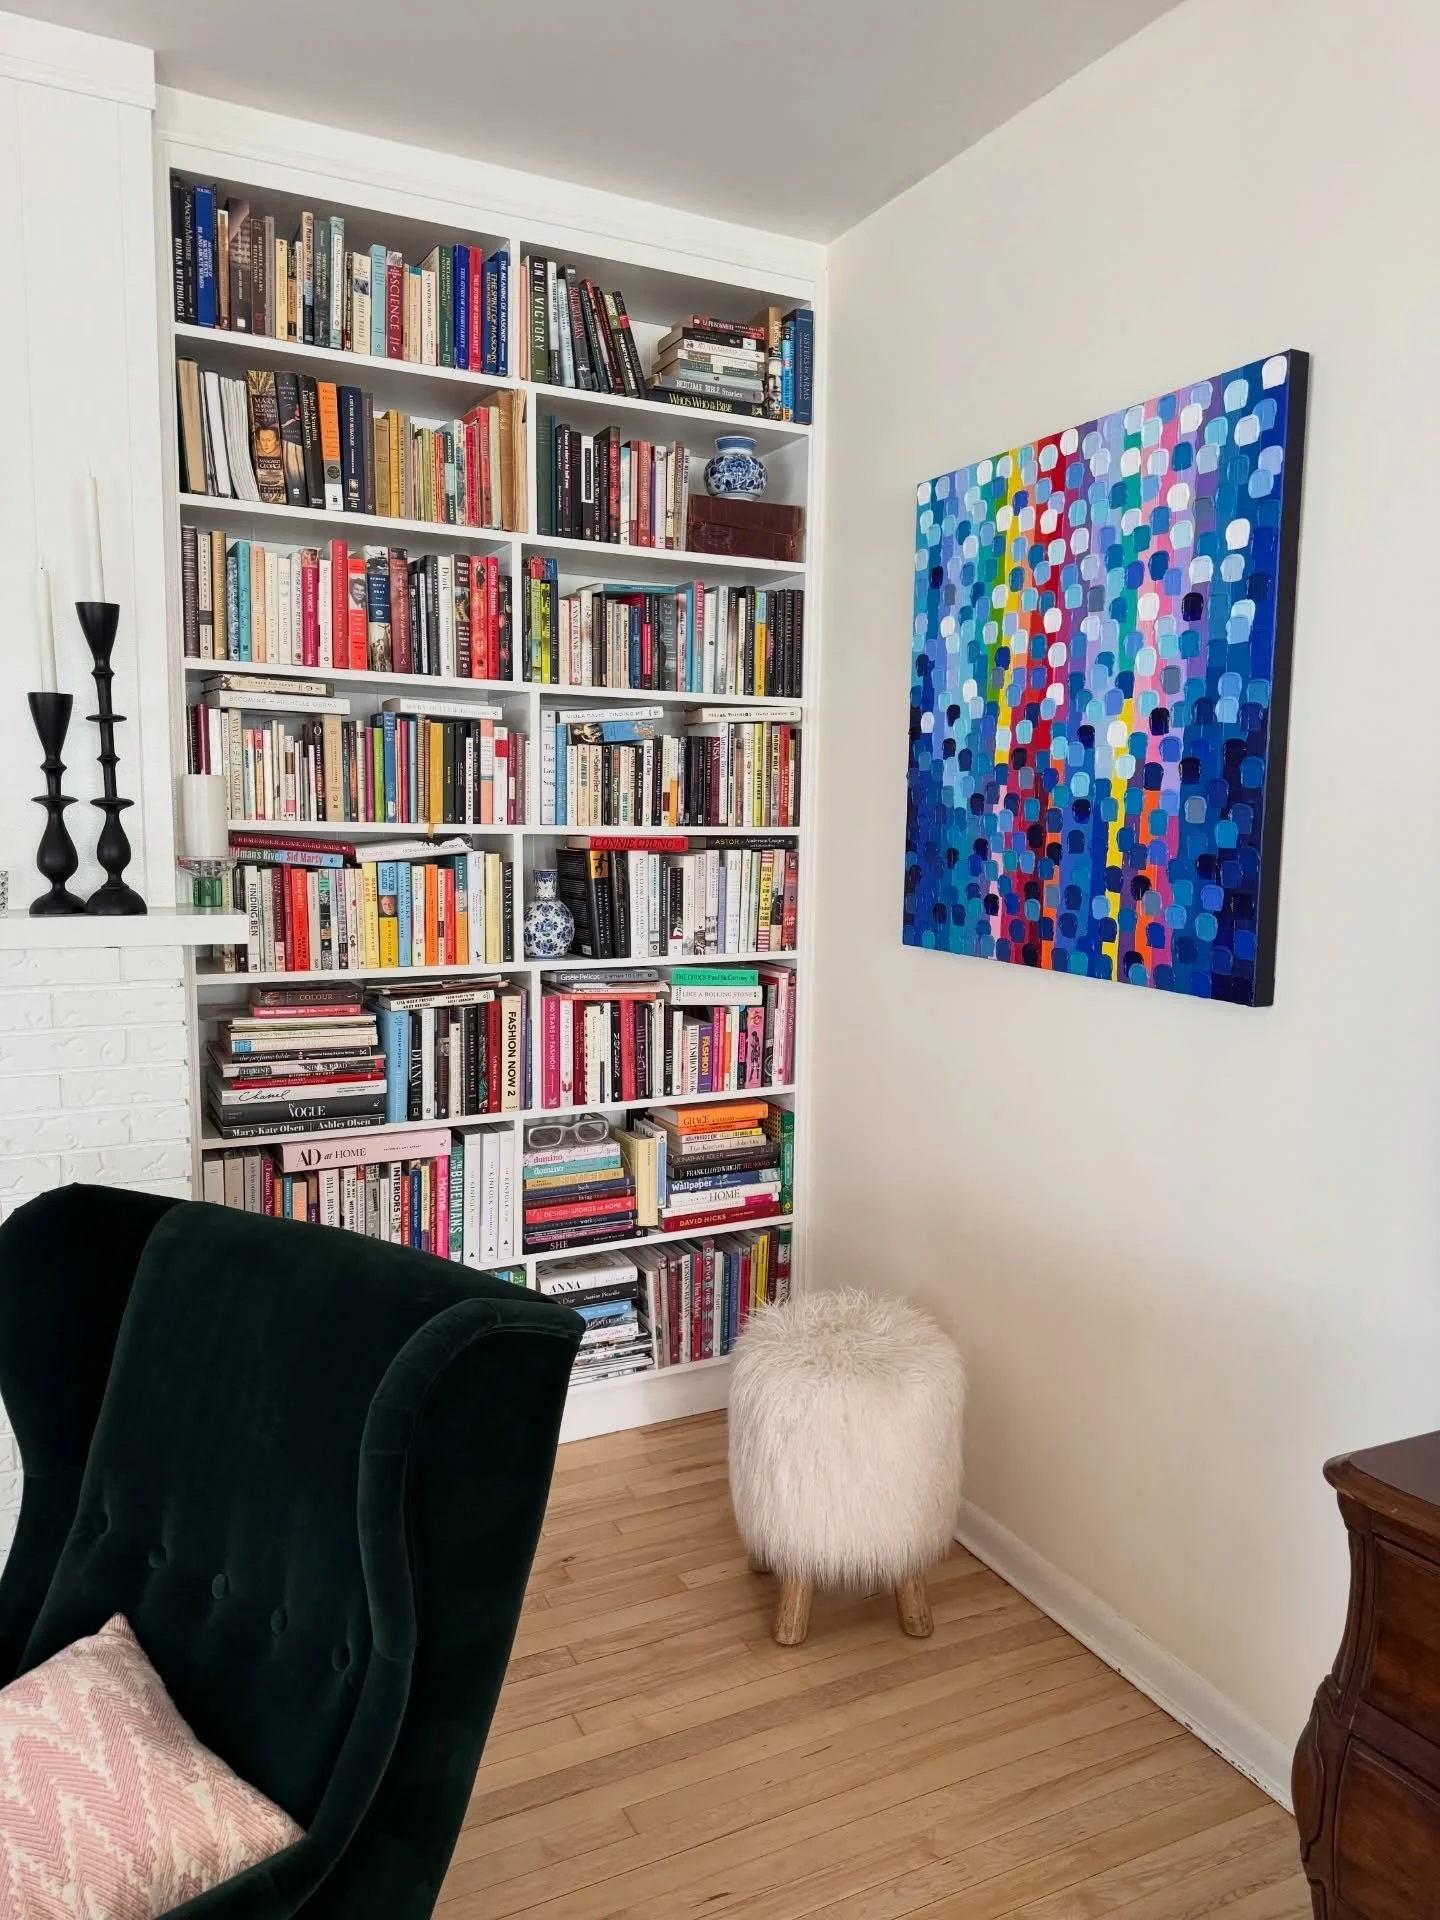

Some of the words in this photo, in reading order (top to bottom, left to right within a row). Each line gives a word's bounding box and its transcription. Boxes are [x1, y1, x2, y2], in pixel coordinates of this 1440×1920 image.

[174, 237, 183, 265] ROMAN
[176, 268, 185, 316] MYTHOLOGY
[390, 279, 400, 330] SCIENCE
[534, 297, 545, 351] VICTORY
[593, 838, 635, 849] CONNIE
[637, 838, 674, 849] CHUNG
[287, 852, 297, 861] Sid
[300, 853, 323, 863] Marty
[250, 883, 258, 918] FINDING
[299, 993, 333, 1001] COLOUR
[508, 1011, 516, 1058] FASHION
[702, 1036, 710, 1076] FASHION
[411, 1049, 421, 1086] DIANA
[508, 1060, 516, 1088] NOW
[238, 1089, 291, 1102] Chanel
[289, 1105, 326, 1118] VOGUE
[232, 1126, 278, 1137] Mary-Kate
[280, 1124, 304, 1132] Olsen
[318, 1120, 348, 1130] Ashley
[349, 1118, 371, 1127] Olsen
[335, 1147, 367, 1159] HOME
[534, 1154, 562, 1163] domino
[533, 1166, 563, 1175] domino
[326, 1177, 334, 1196] BILL
[671, 1179, 712, 1191] Wallpaper
[438, 1177, 448, 1211] Home
[709, 1189, 740, 1201] HOME
[450, 1171, 462, 1234] BOHEMIANS
[327, 1199, 335, 1226] BRYSO
[679, 1216, 702, 1227] DAVID
[704, 1214, 726, 1223] HICKS
[550, 1241, 568, 1250] SHE
[550, 1281, 581, 1293] ANNA
